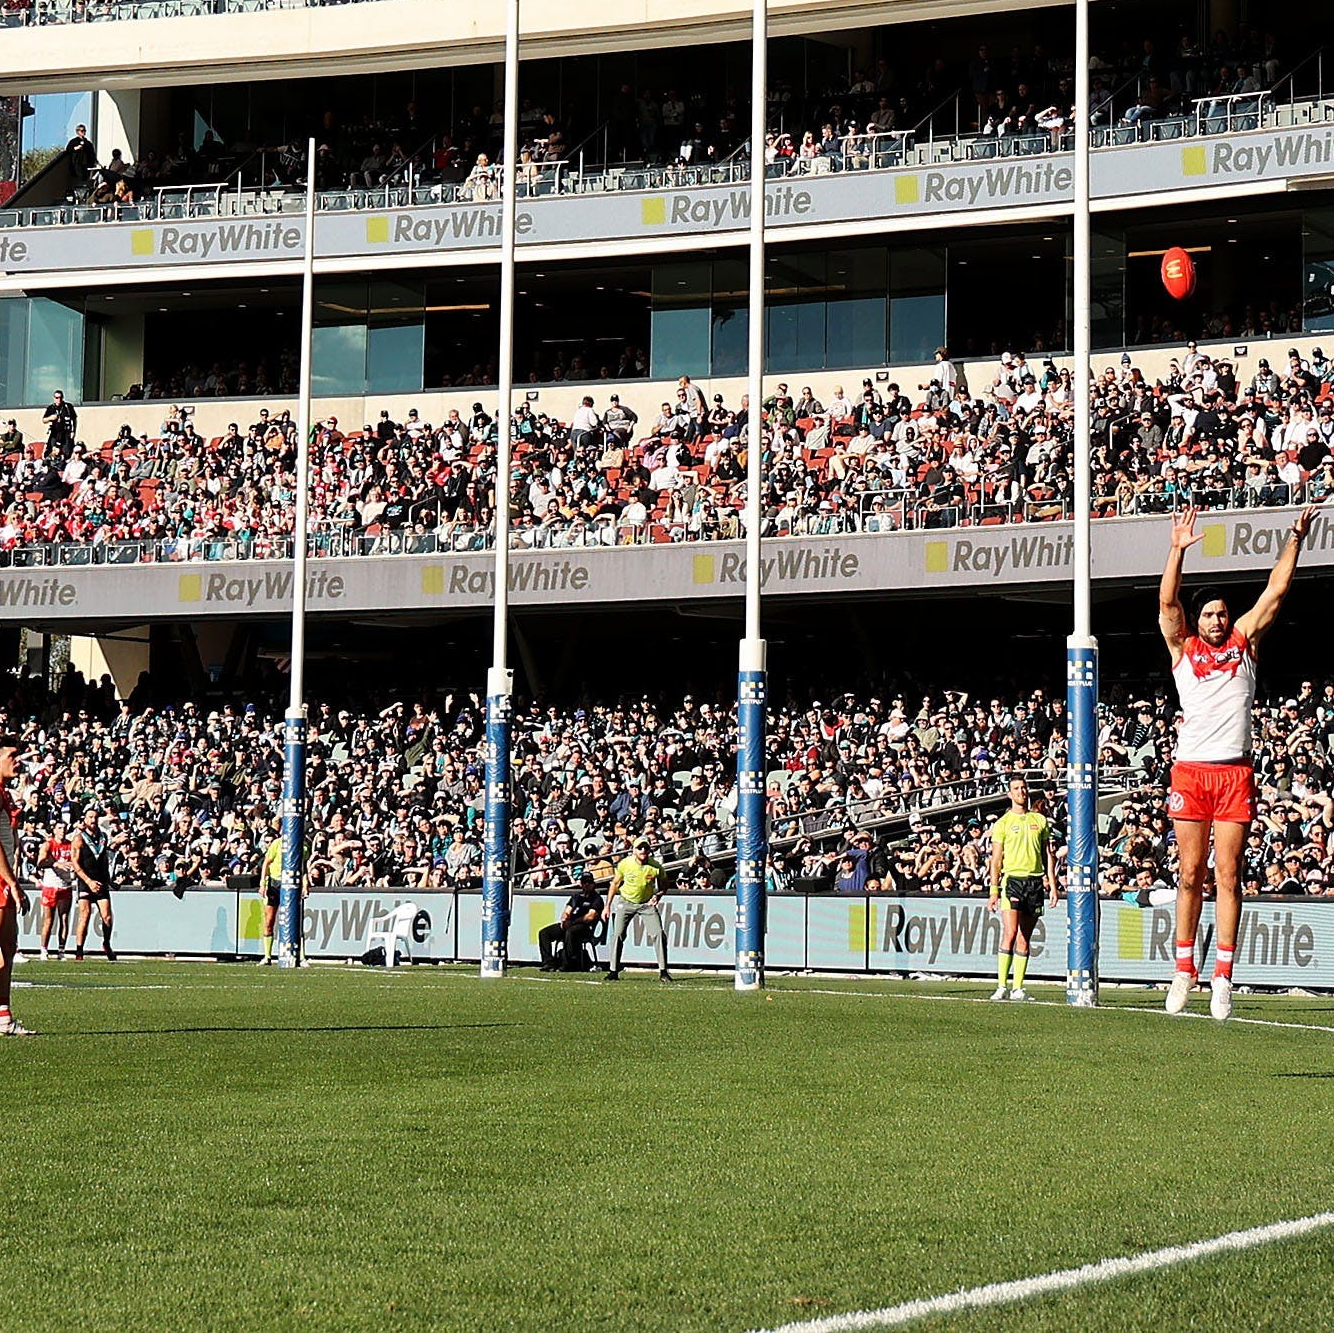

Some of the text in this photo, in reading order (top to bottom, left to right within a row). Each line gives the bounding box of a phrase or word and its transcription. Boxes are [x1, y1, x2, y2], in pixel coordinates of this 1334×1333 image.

[924, 164, 1072, 203] RayWhite
[159, 224, 302, 255] RayWhite
[393, 210, 532, 242] RayWhie
[953, 535, 1075, 576] RayWhit
[883, 904, 1046, 965] RayWhe
[1149, 908, 1315, 974] Ryhite
